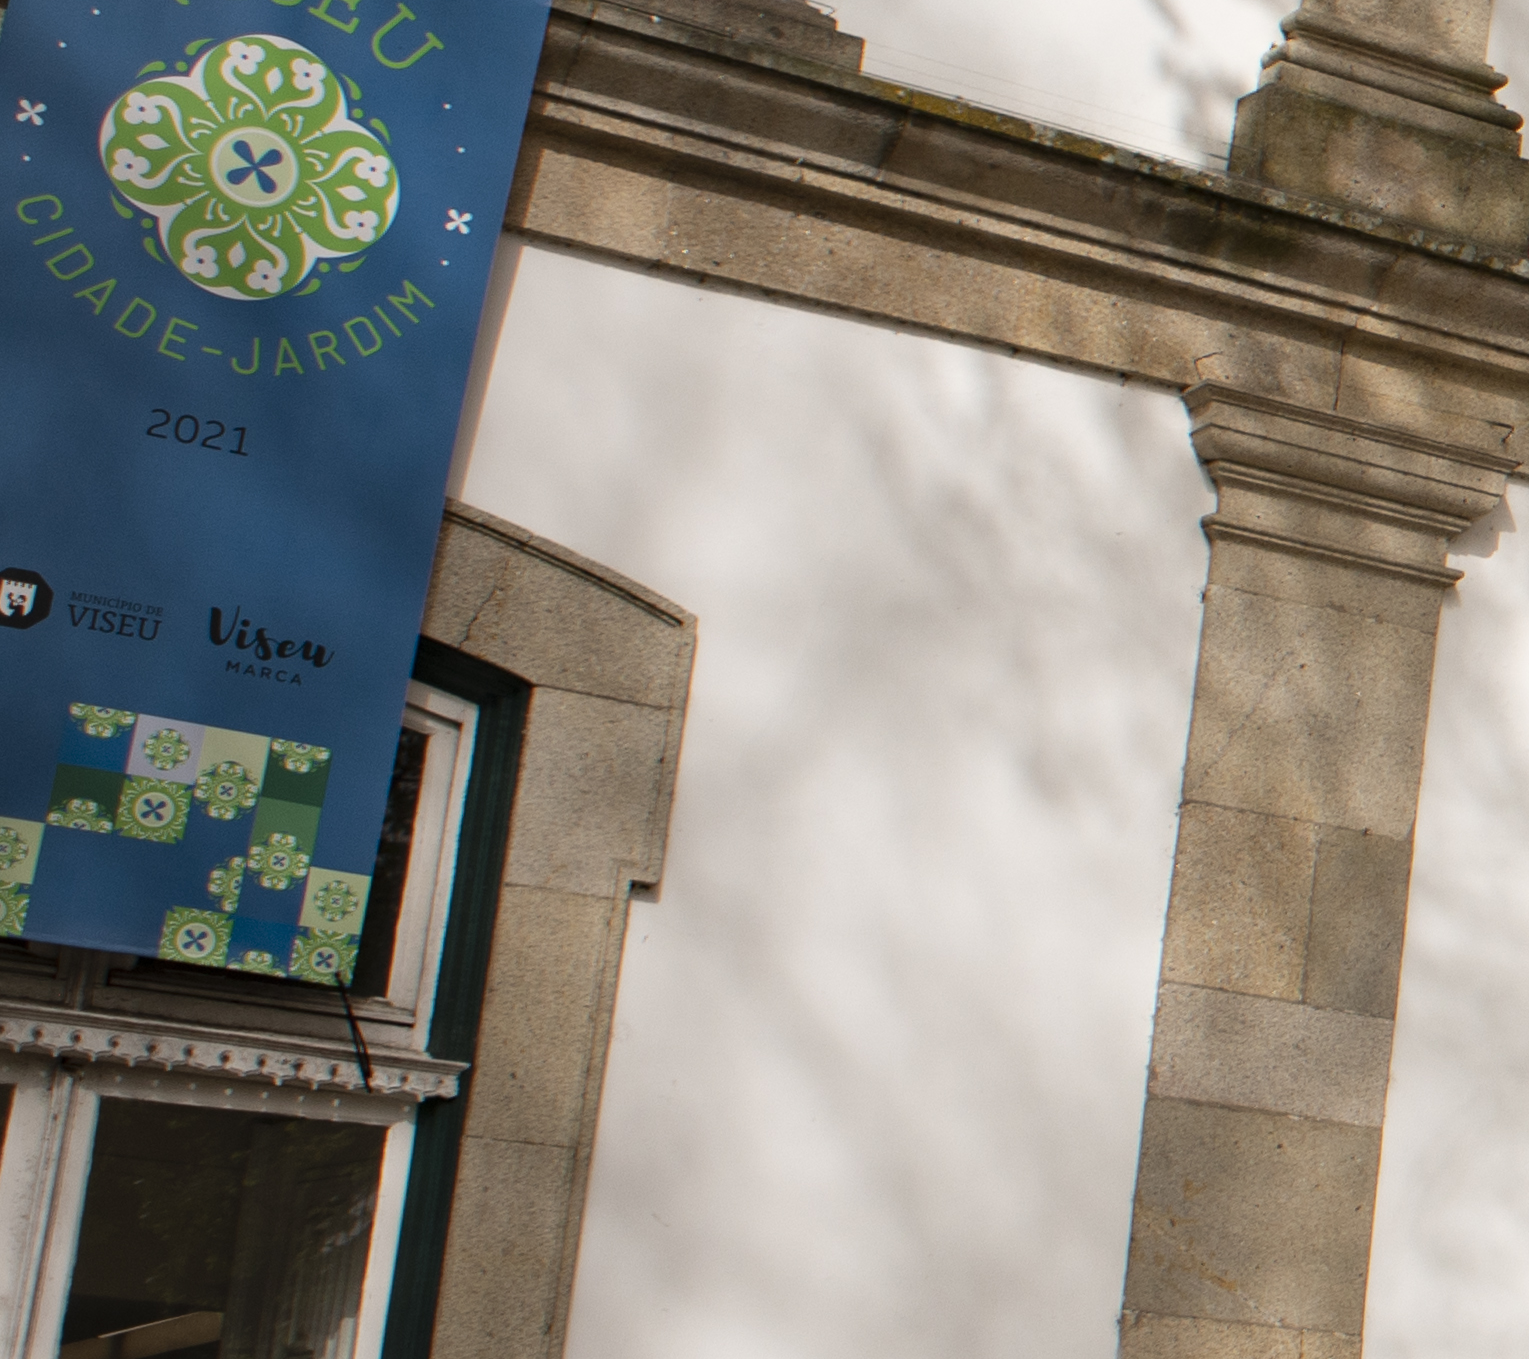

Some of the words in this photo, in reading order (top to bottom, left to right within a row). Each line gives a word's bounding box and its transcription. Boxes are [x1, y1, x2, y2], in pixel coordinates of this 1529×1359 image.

[15, 193, 436, 376] CIDADE-JARDIM
[145, 407, 251, 457] 2021
[68, 604, 162, 641] VISEU
[71, 591, 142, 613] MUNICÍPIO
[146, 604, 164, 617] DE
[209, 605, 335, 668] Viseu
[225, 660, 303, 686] MARCA
